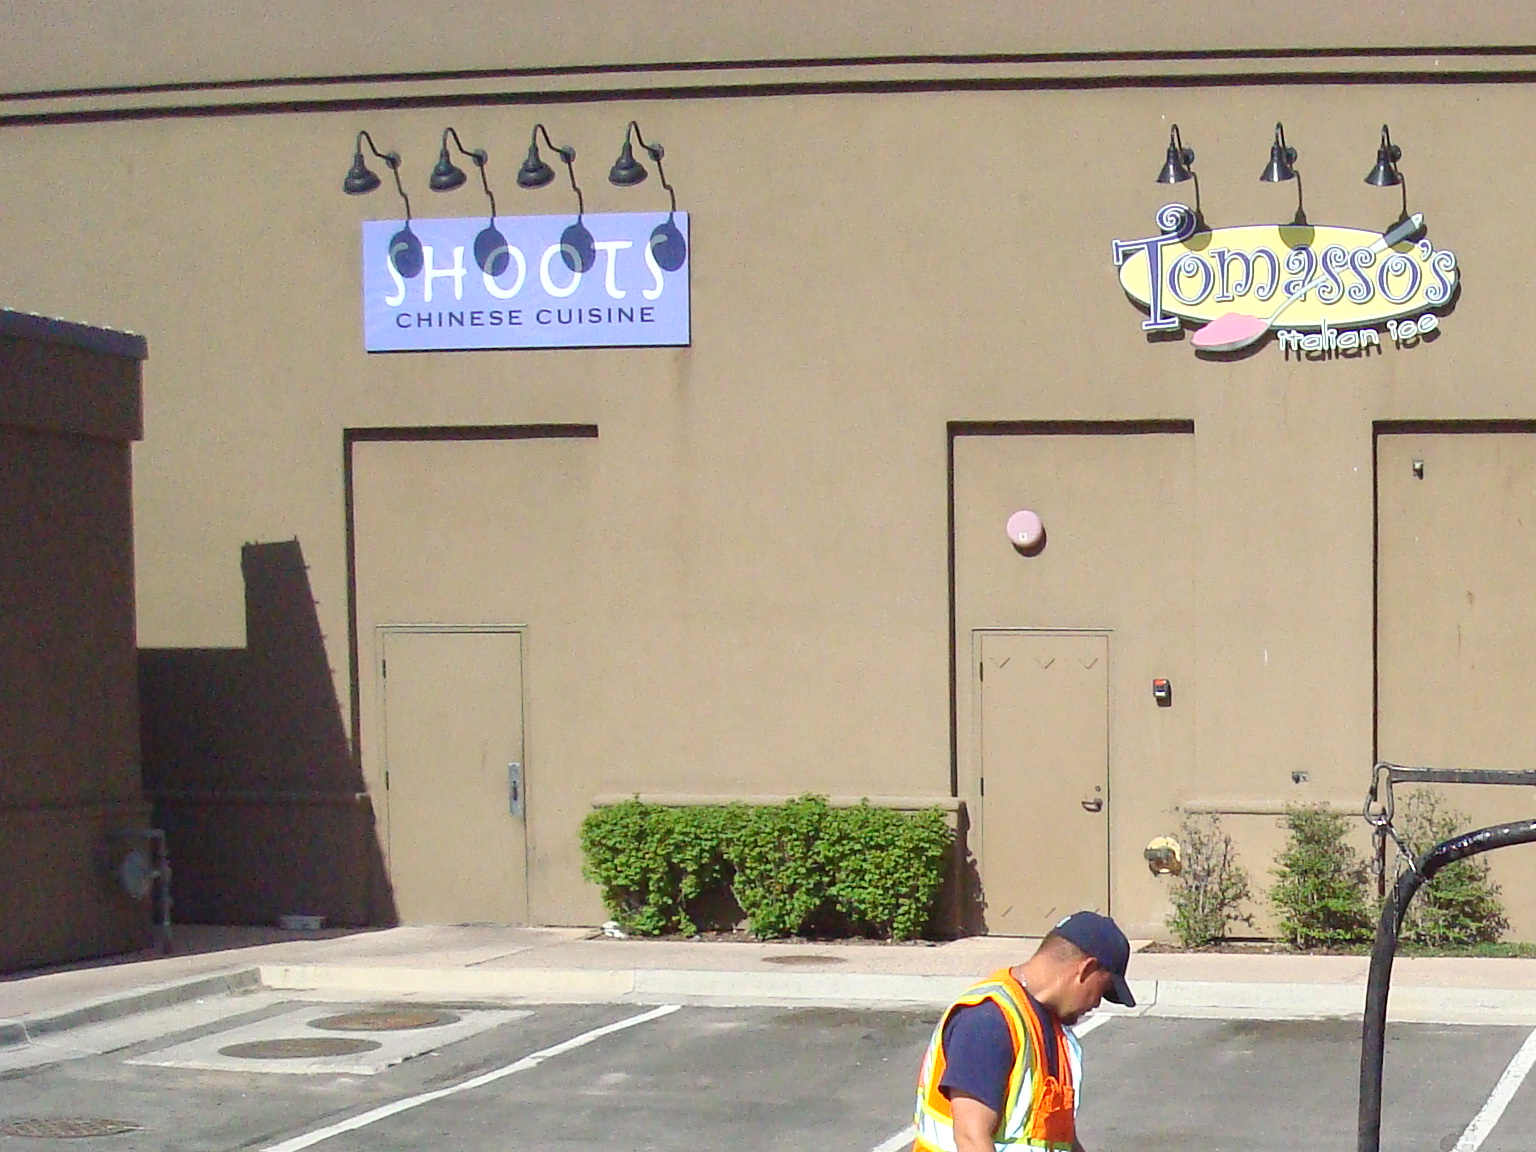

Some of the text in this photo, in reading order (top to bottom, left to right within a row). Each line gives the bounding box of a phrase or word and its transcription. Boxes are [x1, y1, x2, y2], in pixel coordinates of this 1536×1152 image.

[384, 234, 668, 307] SHOOTS
[1112, 203, 1457, 331] Tomasso's
[396, 307, 655, 329] CHINESE CUISINE
